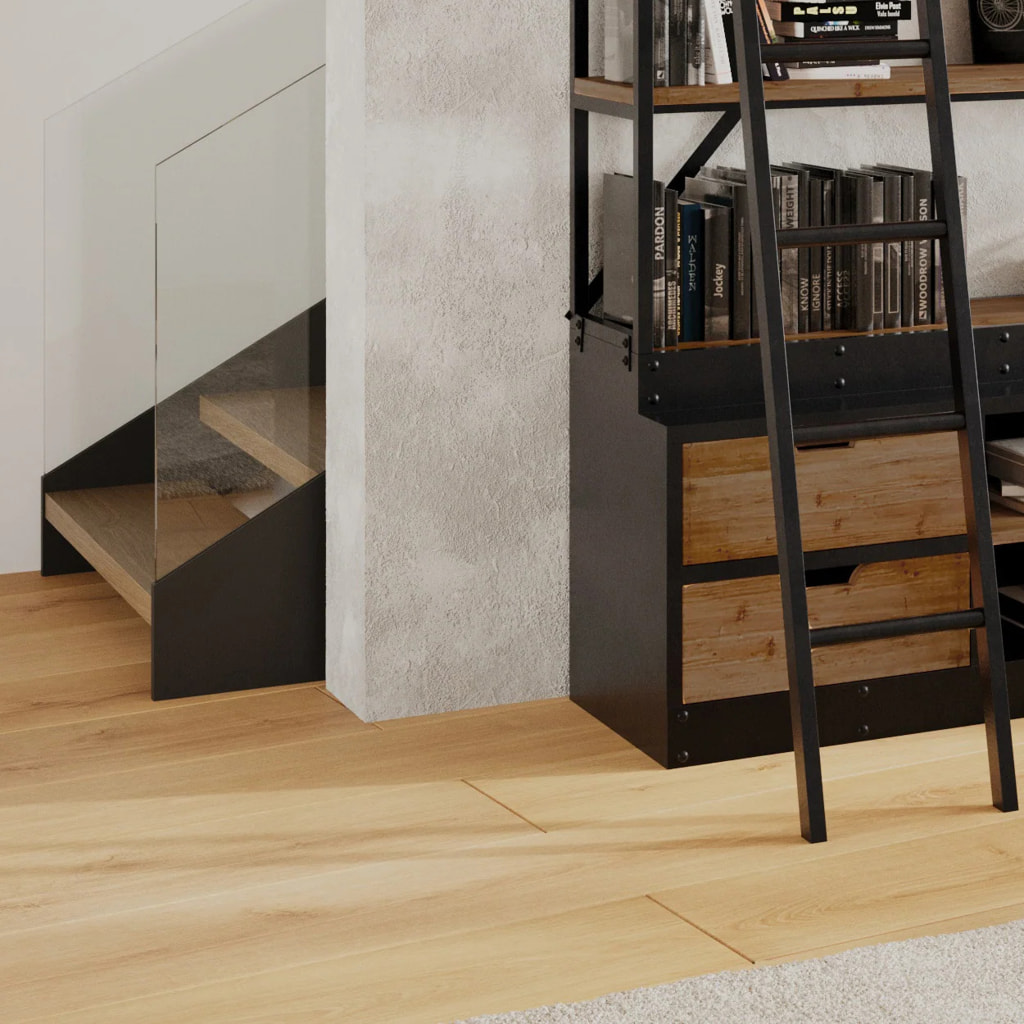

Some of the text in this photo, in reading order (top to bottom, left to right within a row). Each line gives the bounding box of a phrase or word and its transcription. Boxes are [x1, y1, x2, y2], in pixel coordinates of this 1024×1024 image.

[793, 5, 858, 15] PALSU
[786, 185, 795, 229] WEIGHT
[654, 206, 665, 260] PARDON
[687, 234, 697, 291] WALDEN
[713, 263, 726, 298] Jockey
[919, 248, 928, 311] WOODROW
[667, 280, 677, 330] ARCHIMEDES
[800, 277, 809, 311] KNOW
[812, 273, 821, 311] IGNORE
